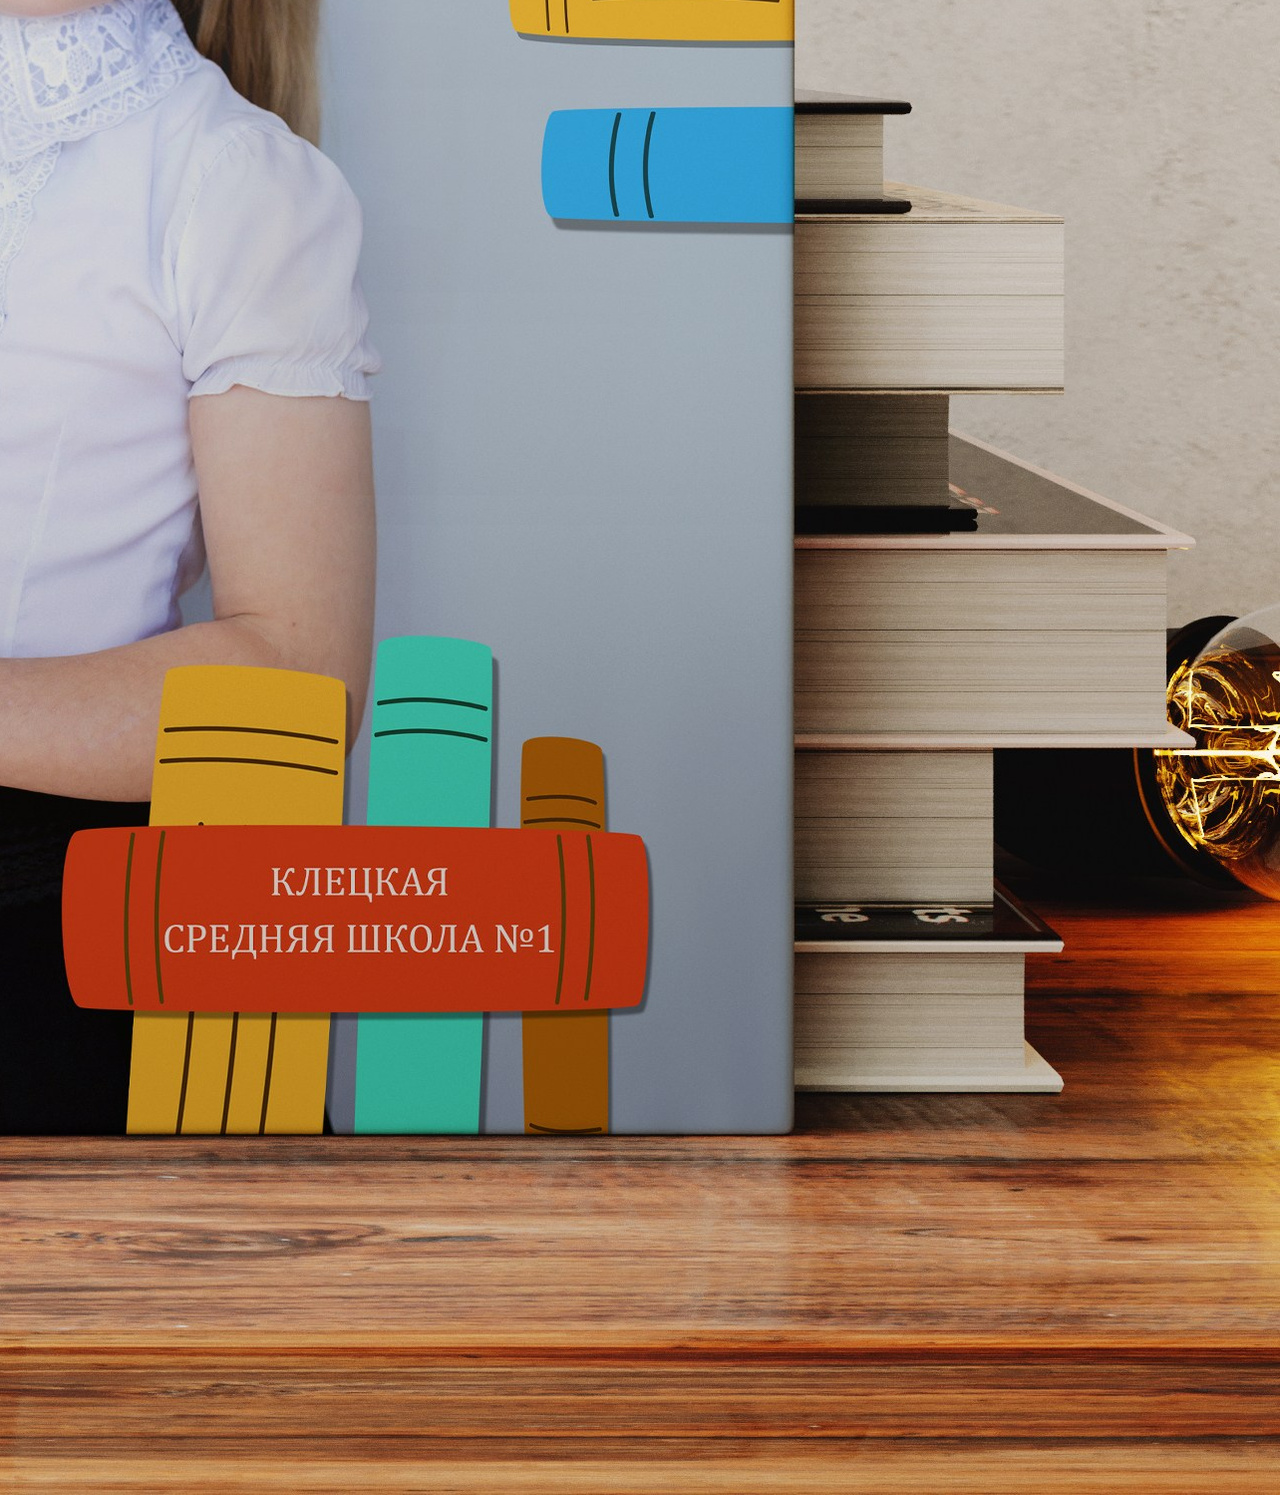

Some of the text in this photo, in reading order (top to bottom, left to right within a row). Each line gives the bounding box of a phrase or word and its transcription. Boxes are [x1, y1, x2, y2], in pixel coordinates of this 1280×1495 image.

[271, 867, 448, 903] КЛЕЦКАЯ
[164, 924, 555, 960] СРЕДНЯЯ ШКОЛА №1
